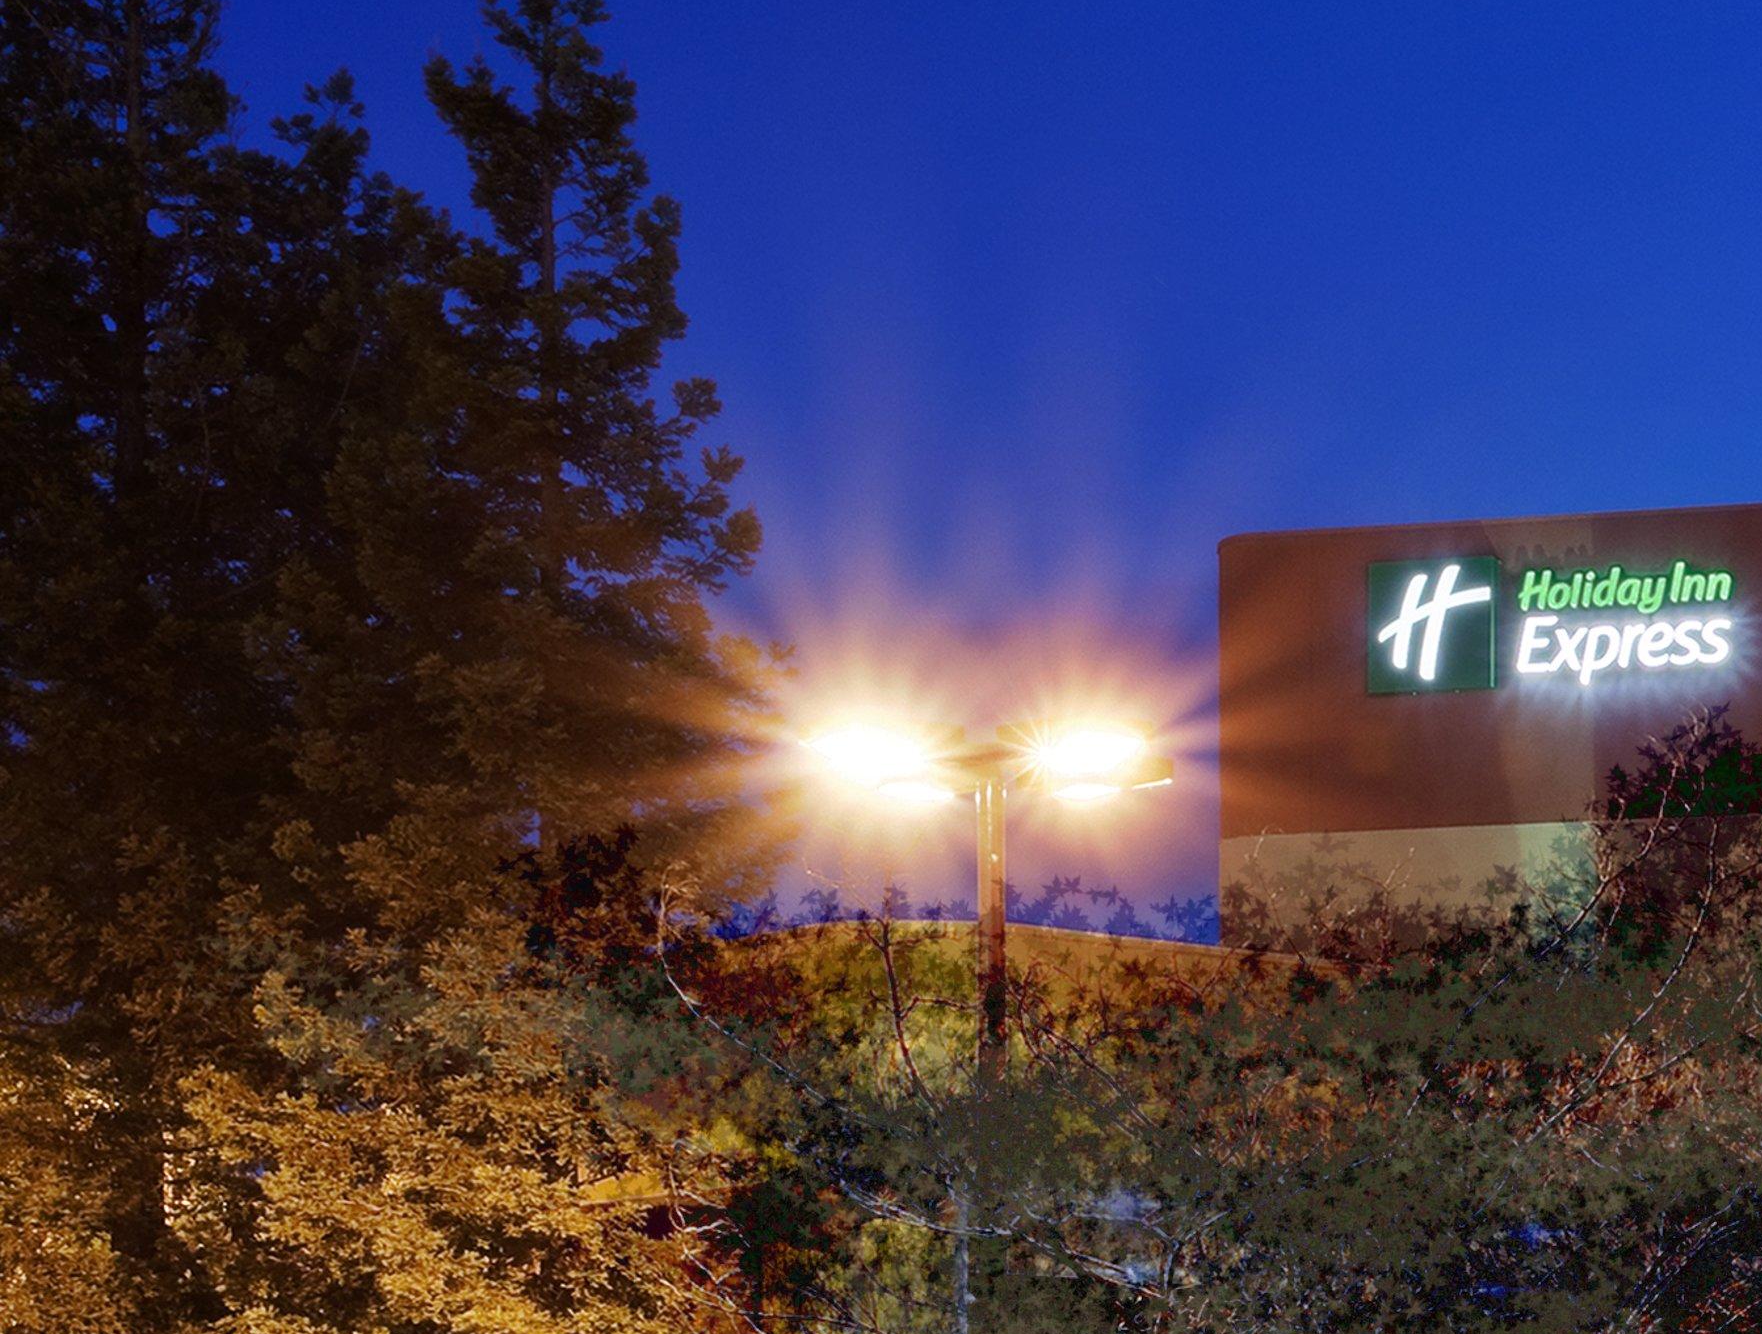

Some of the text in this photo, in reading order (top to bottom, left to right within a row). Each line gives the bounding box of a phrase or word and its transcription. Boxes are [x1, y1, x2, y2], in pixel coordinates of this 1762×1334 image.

[1517, 561, 1732, 614] Holiday Inn
[1516, 614, 1732, 686] Express
